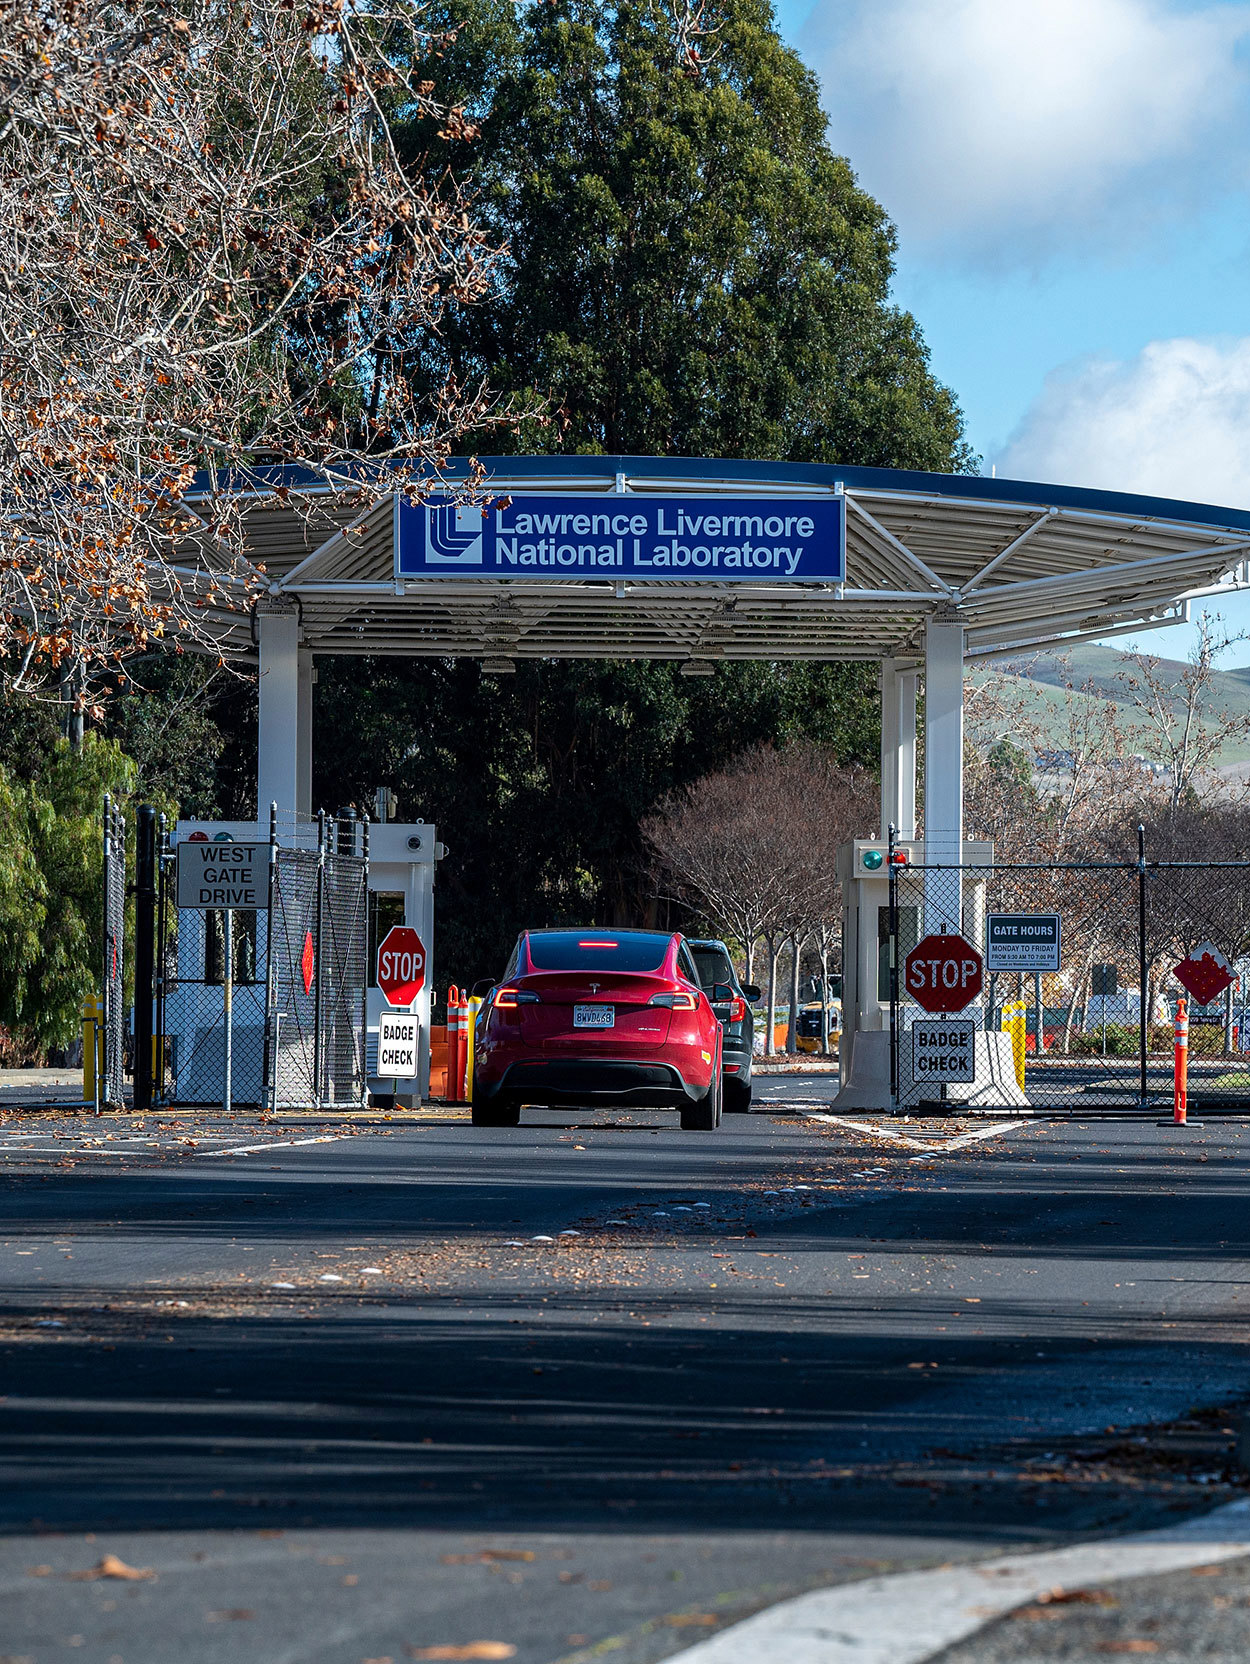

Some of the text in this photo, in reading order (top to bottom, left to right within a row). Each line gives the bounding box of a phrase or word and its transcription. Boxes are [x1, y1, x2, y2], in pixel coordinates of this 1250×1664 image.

[495, 508, 815, 537] Lawrence Livermore
[495, 537, 803, 575] National Laboratory
[200, 847, 256, 862] WEST
[203, 868, 253, 883] GATE
[200, 889, 256, 904] DRIVE
[993, 925, 1053, 936] GATE HOURS
[381, 951, 423, 981] STOP
[910, 959, 978, 988] STOP
[383, 1025, 414, 1041] BADGE
[919, 1032, 968, 1047] BADGE
[382, 1049, 413, 1065] CHECK
[918, 1056, 969, 1071] CHECK
